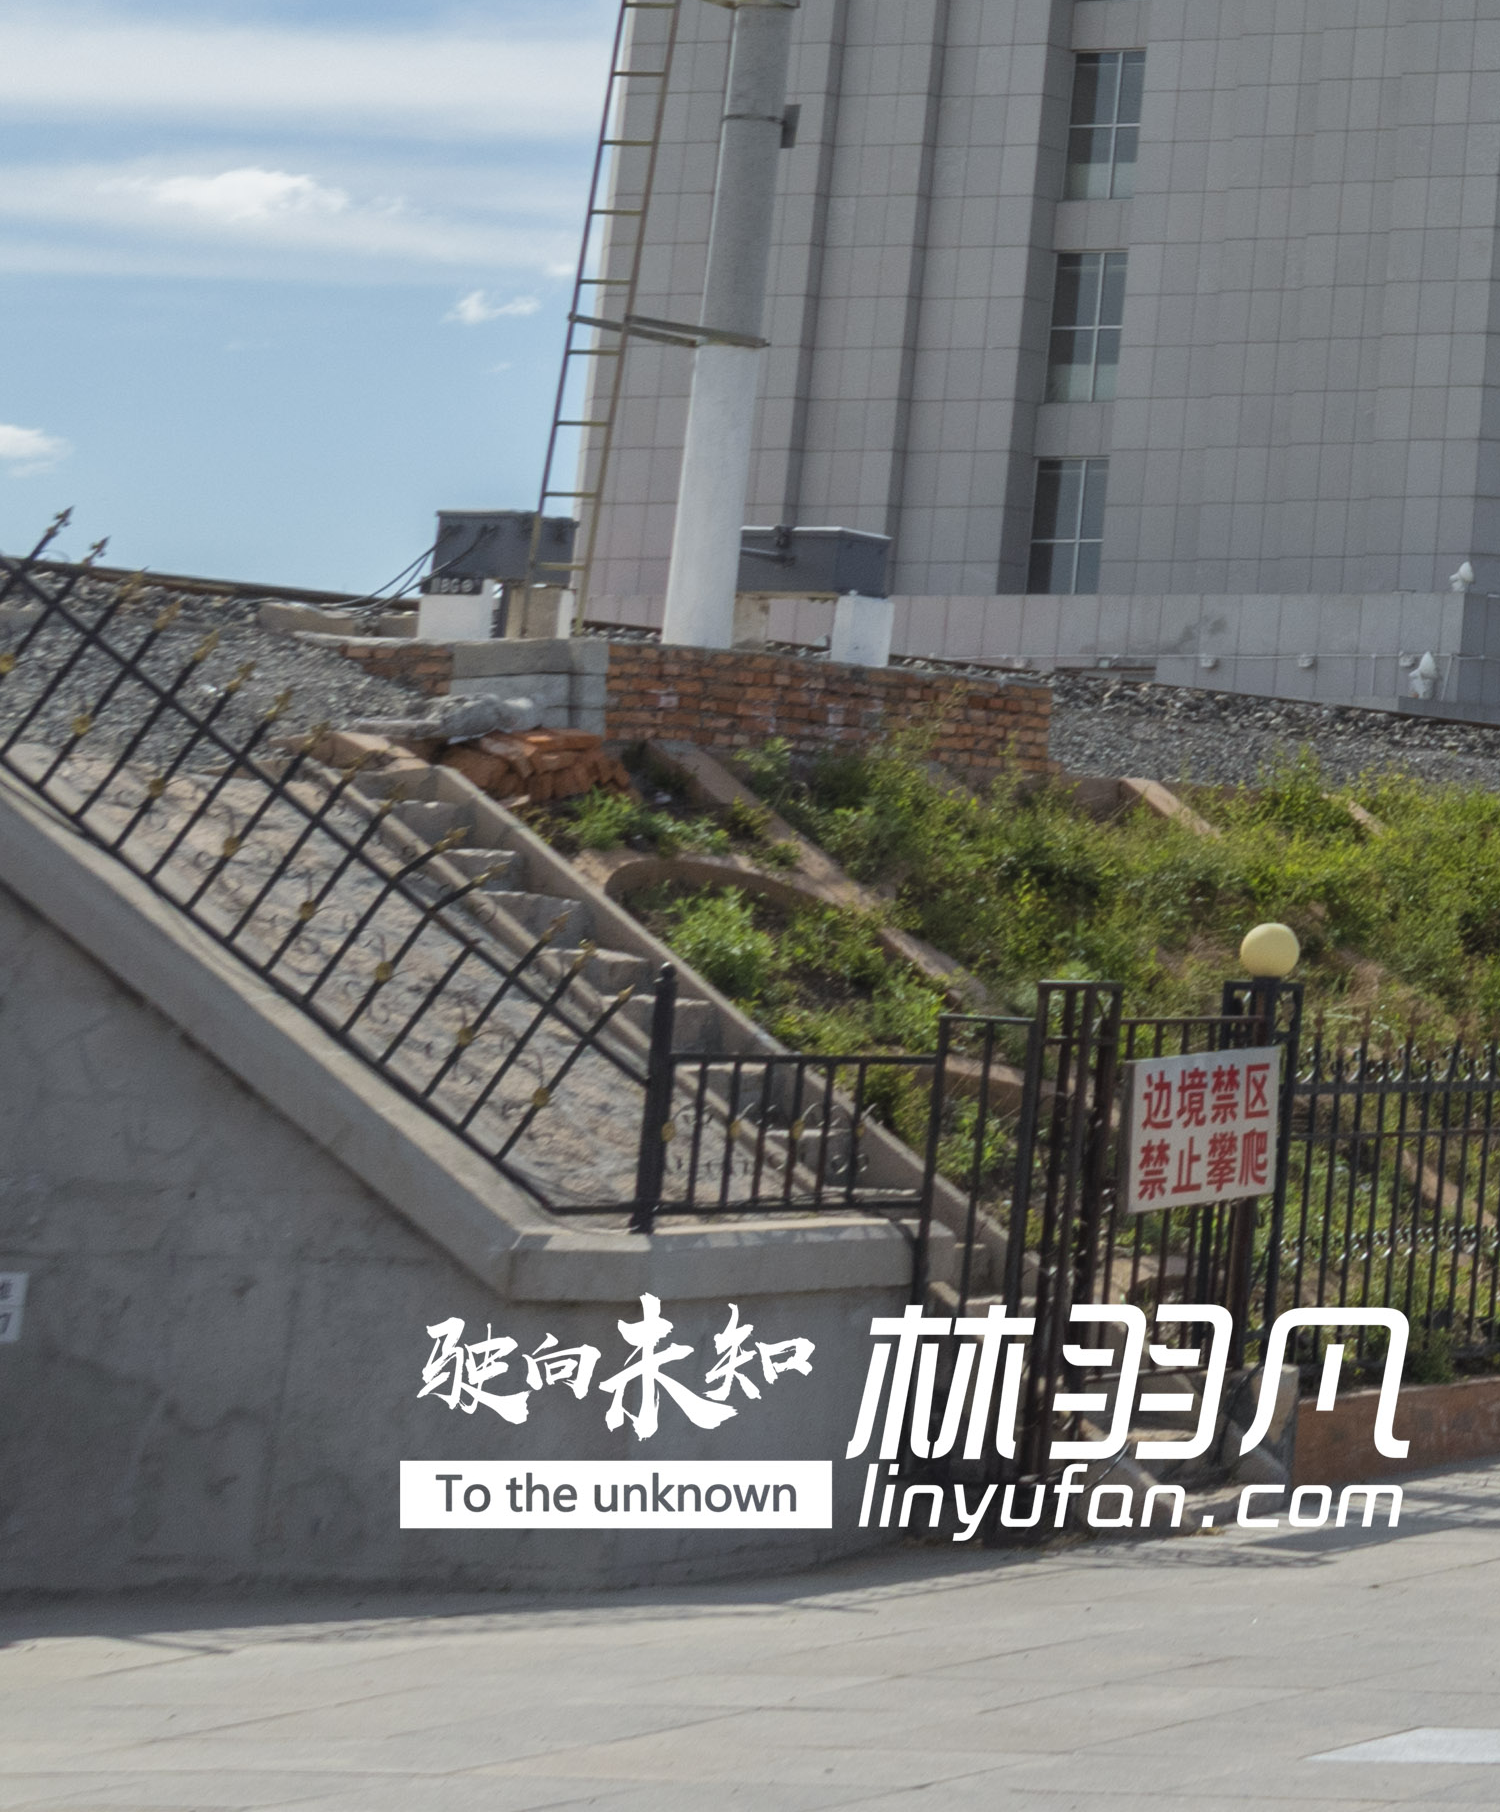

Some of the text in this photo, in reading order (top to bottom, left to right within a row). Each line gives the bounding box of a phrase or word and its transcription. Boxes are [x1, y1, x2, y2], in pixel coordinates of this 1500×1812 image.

[1141, 1062, 1271, 1131] 边境禁区
[1137, 1127, 1269, 1202] 禁止攀爬
